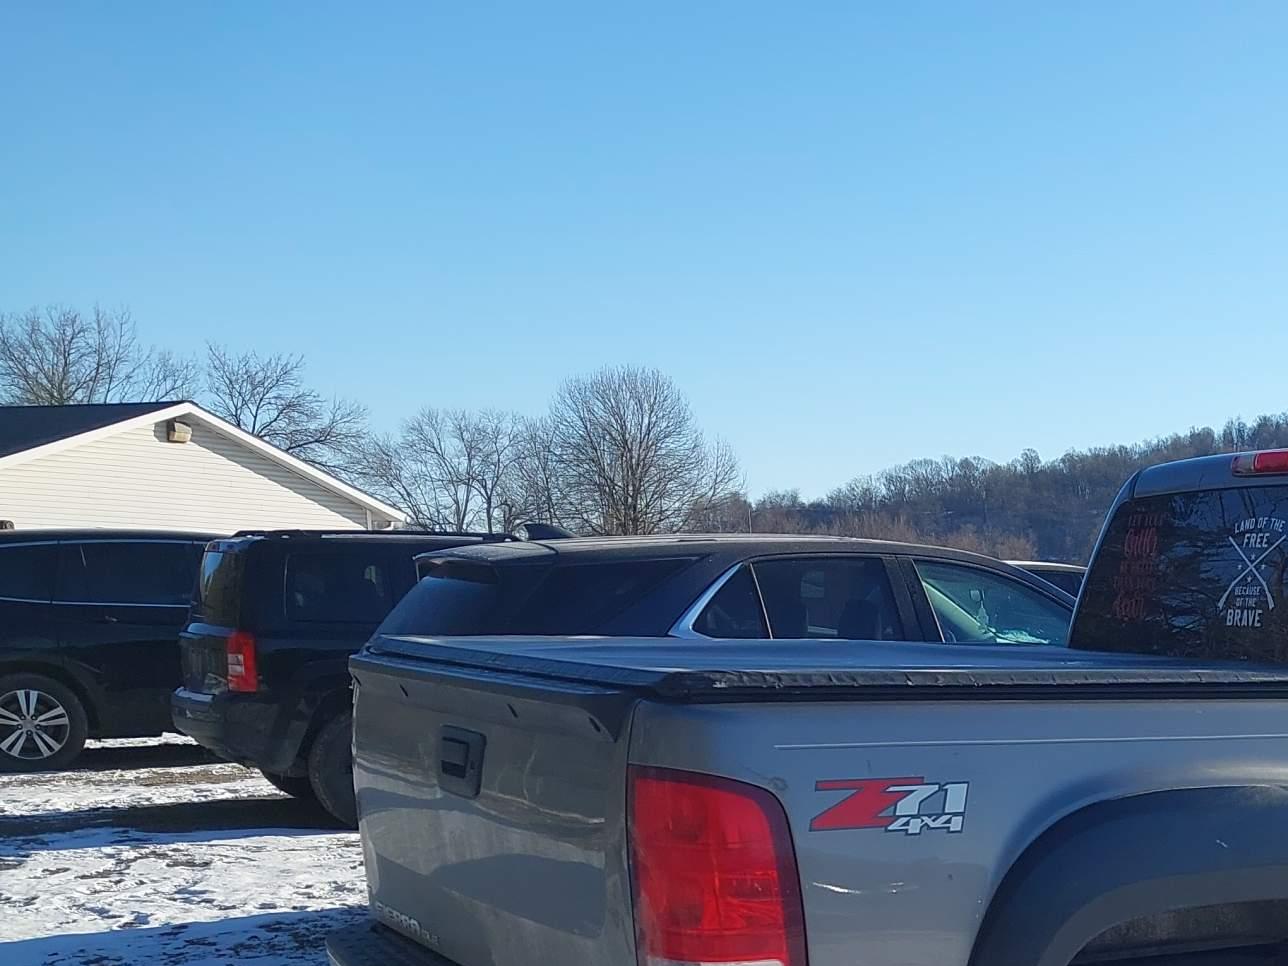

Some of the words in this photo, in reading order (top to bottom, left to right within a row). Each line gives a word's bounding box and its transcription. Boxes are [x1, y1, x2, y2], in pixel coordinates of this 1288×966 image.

[1234, 517, 1256, 534] LAND
[1257, 516, 1269, 529] OF
[1270, 517, 1286, 532] THE
[1242, 532, 1270, 548] FREE
[1234, 586, 1261, 596] BECAUSE
[1235, 597, 1245, 608] OF
[1246, 597, 1257, 608] THE
[1226, 609, 1263, 627] BRAVE
[808, 776, 970, 832] Z71
